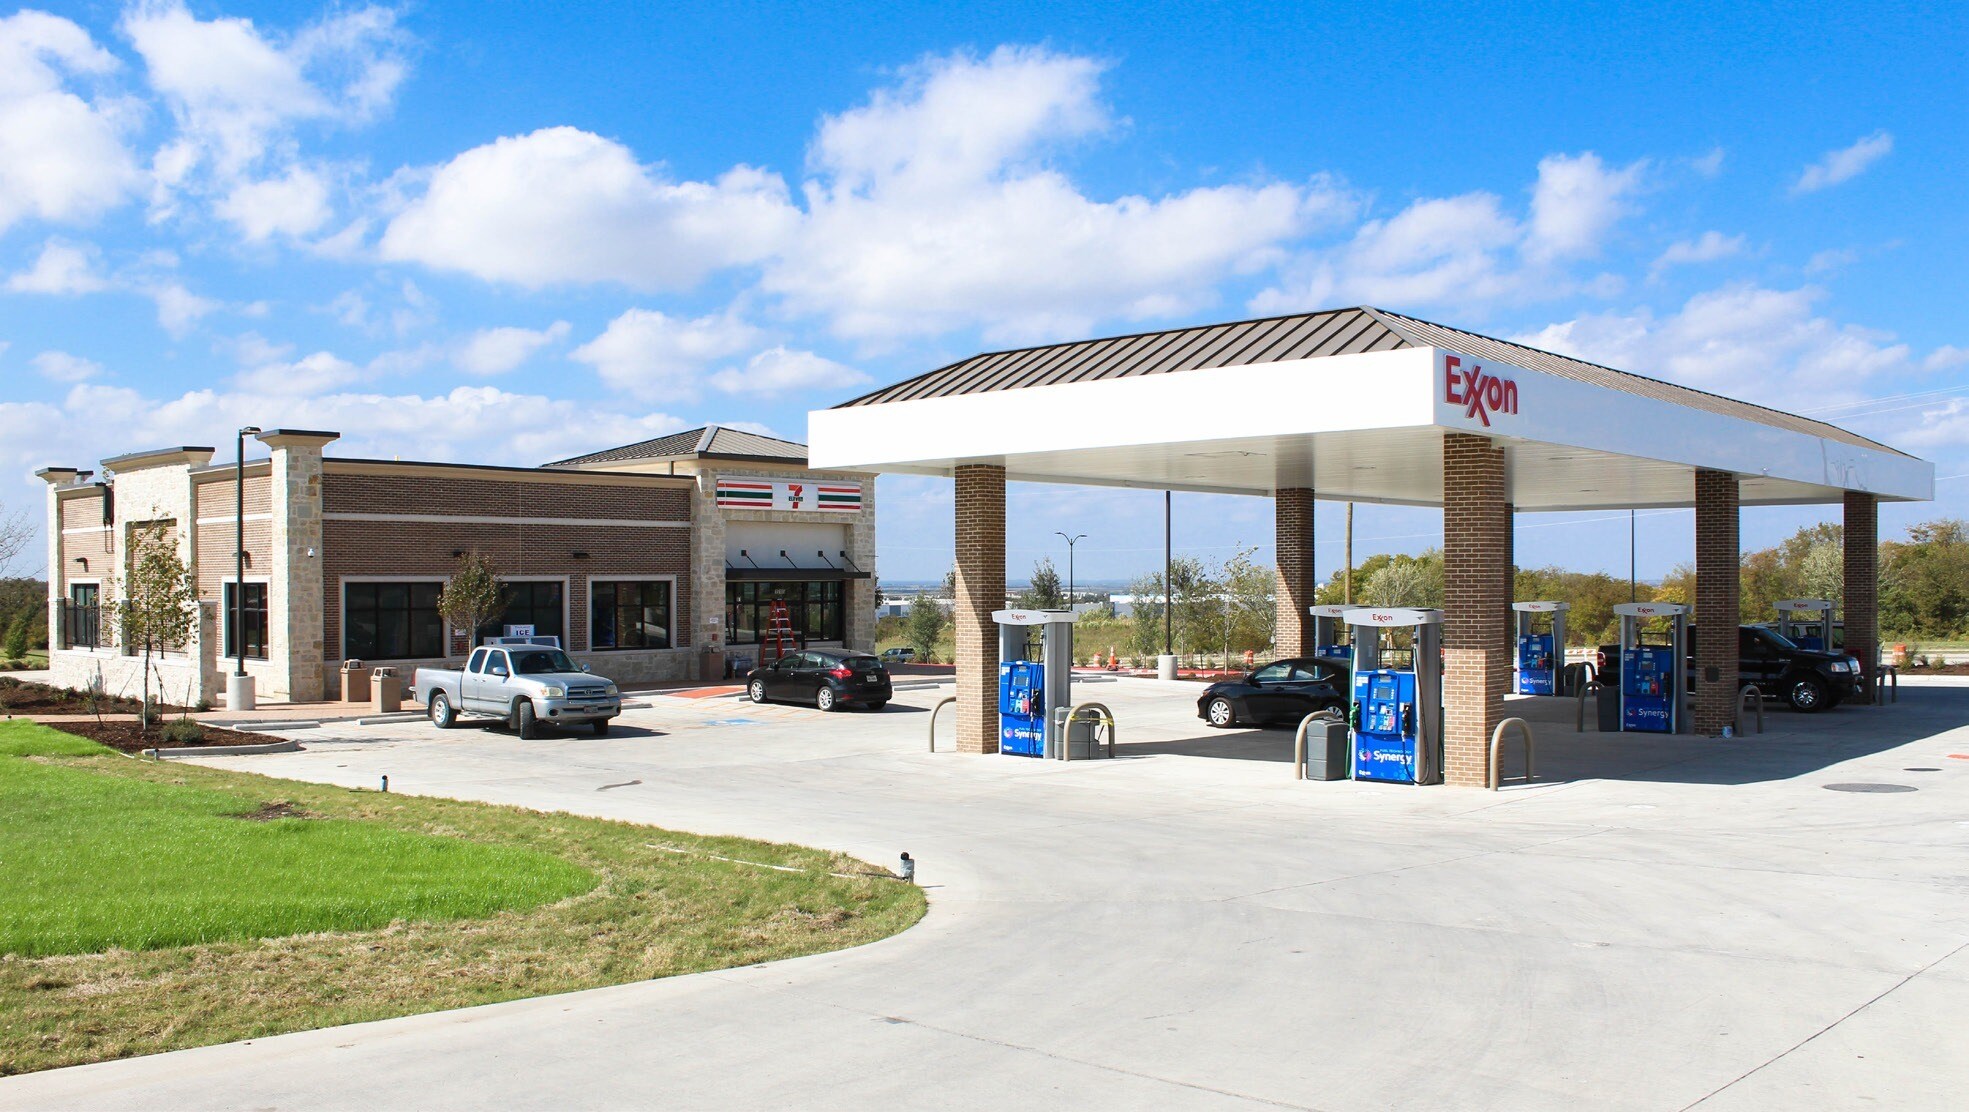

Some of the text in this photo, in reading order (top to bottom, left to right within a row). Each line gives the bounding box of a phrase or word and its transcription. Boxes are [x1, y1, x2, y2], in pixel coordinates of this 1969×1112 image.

[1445, 355, 1517, 427] Exxon
[788, 484, 803, 509] 7
[1011, 613, 1027, 622] Exxon
[1372, 613, 1393, 623] Exxon
[1638, 707, 1669, 719] Synergy
[1014, 728, 1042, 741] Synergy
[1373, 750, 1413, 765] Synergy
